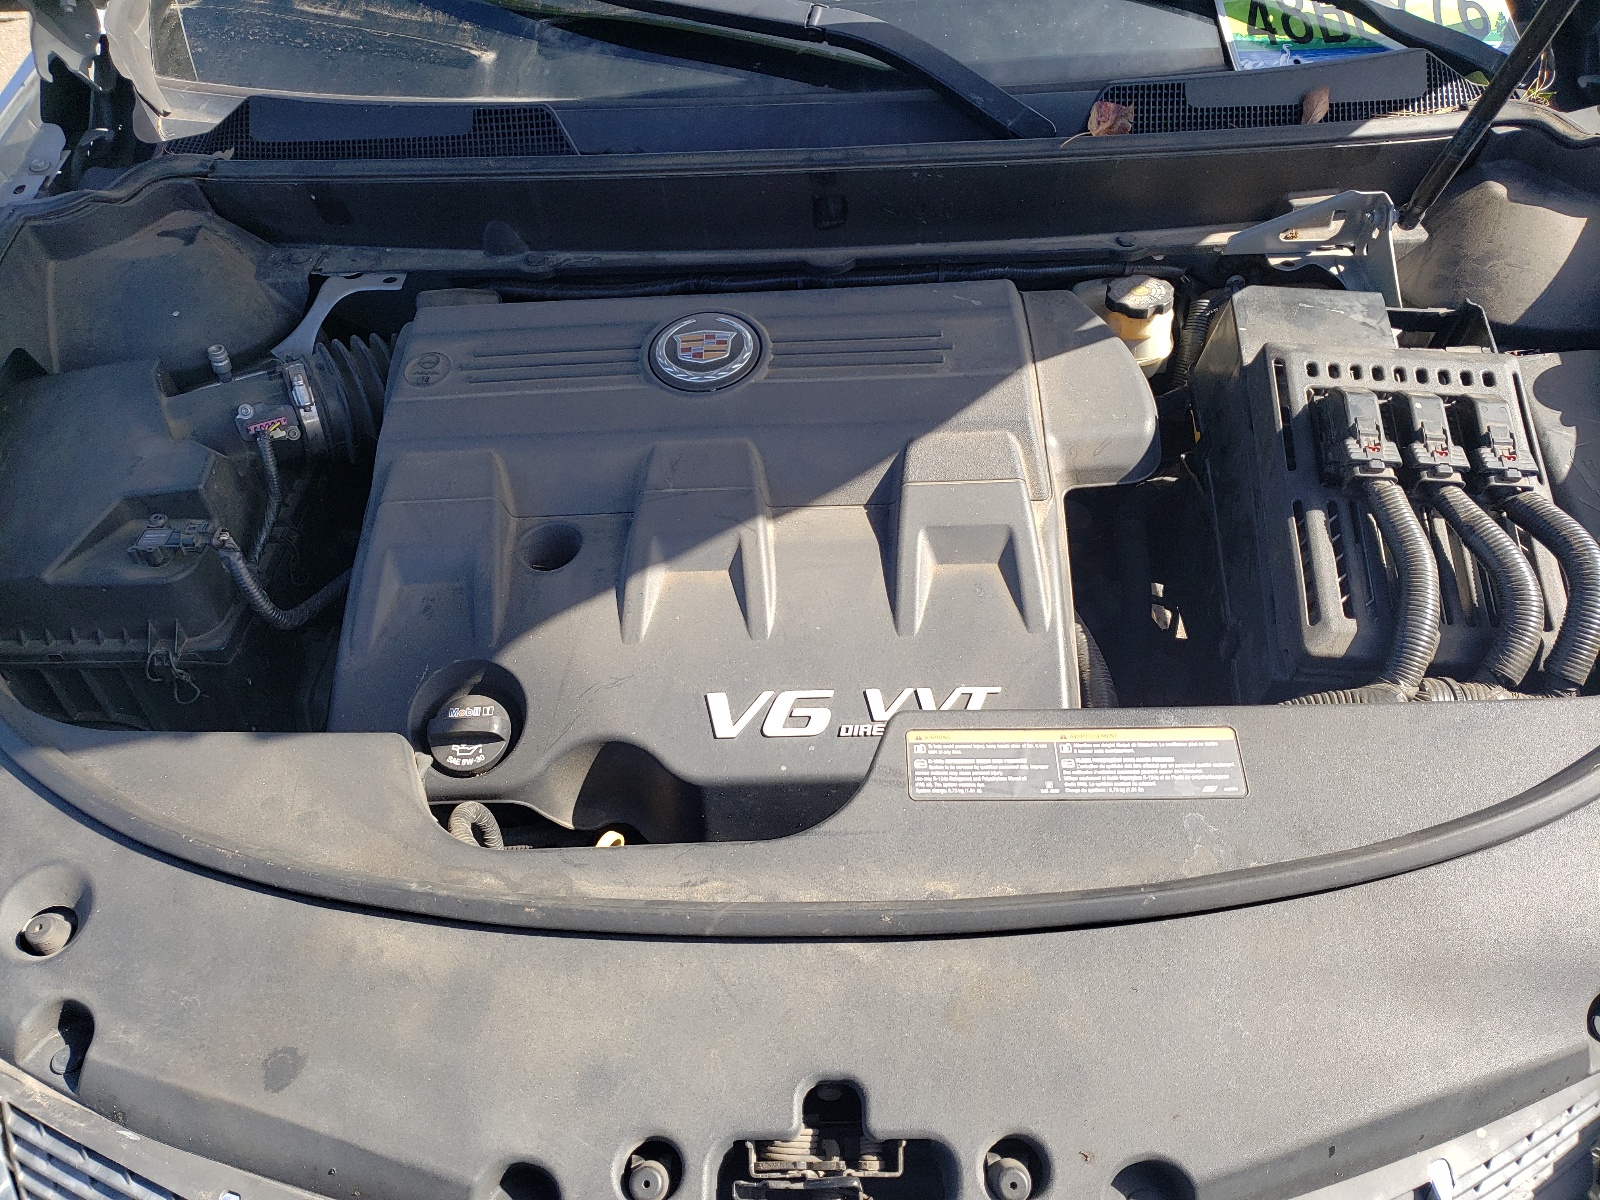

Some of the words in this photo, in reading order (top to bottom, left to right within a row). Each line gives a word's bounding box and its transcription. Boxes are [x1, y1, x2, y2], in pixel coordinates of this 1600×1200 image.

[449, 706, 481, 717] Mobil
[704, 690, 834, 739] V6
[863, 687, 1002, 722] VVT
[447, 755, 461, 766] SAE
